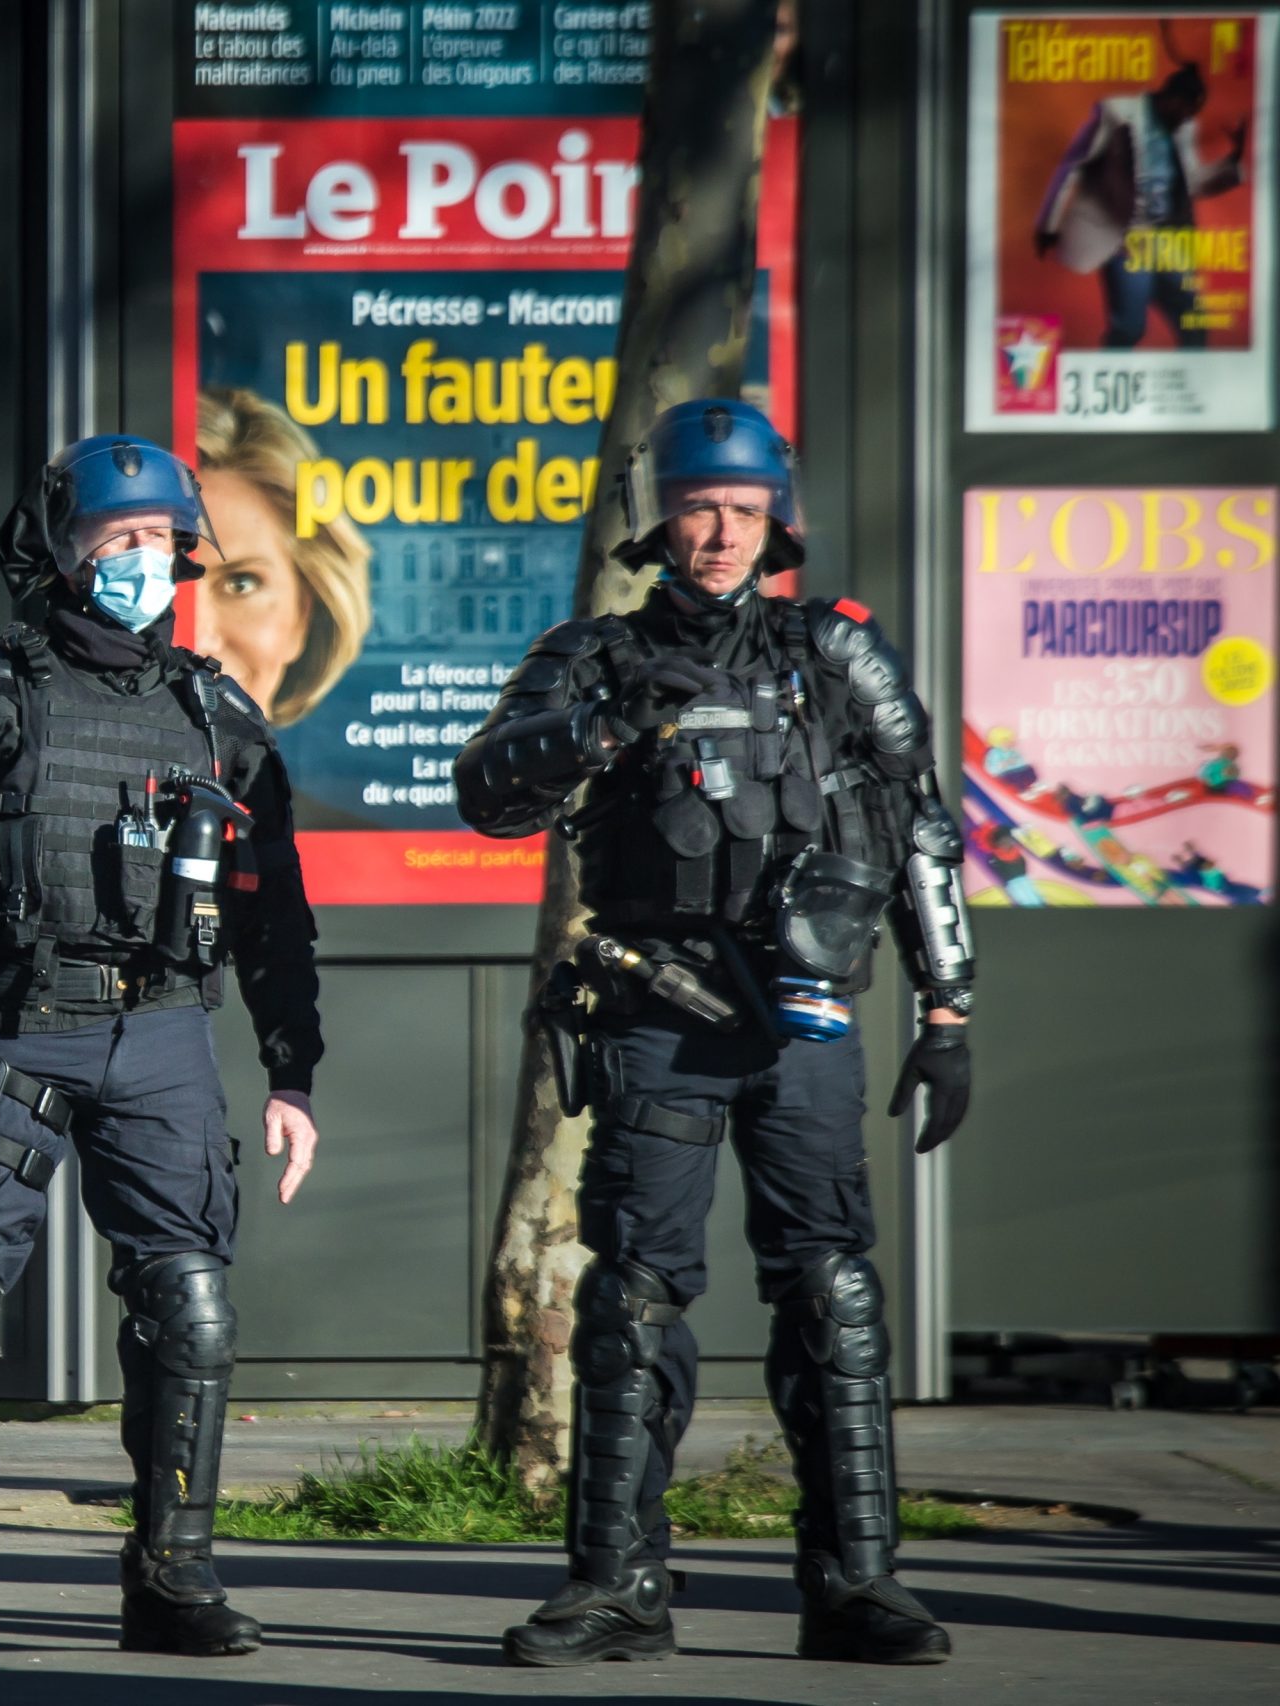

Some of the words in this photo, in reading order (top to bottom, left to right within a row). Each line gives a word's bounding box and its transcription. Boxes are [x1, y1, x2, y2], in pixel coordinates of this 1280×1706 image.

[330, 7, 404, 31] Michelin
[474, 8, 517, 30] 2022
[195, 35, 215, 58] Le
[219, 34, 266, 58] tabou
[271, 35, 302, 58] des
[554, 35, 575, 57] Ce
[619, 33, 651, 57] fau
[1004, 24, 1153, 82] Télérama
[195, 61, 312, 86] maltraitances
[330, 62, 352, 85] du
[357, 62, 401, 88] pneu
[422, 62, 452, 85] des
[554, 62, 583, 85] des
[238, 143, 375, 240] Le
[1124, 229, 1246, 272] STROMAE
[352, 290, 479, 326] Pécresse
[508, 291, 620, 326] Macron
[286, 341, 388, 425] Un
[296, 457, 473, 538] pour
[977, 494, 1276, 574] L'OBS
[1024, 600, 1224, 658] PARCOURSUP
[401, 664, 424, 686] La
[427, 663, 489, 686] féroce
[1054, 680, 1099, 706] LES
[1104, 663, 1188, 706] 350
[371, 692, 418, 714] pour
[420, 689, 438, 711] la
[346, 722, 370, 745] Ce
[373, 722, 405, 749] qui
[408, 722, 438, 745] les
[440, 722, 484, 745] dist
[1020, 708, 1223, 740] FORMATIONS
[412, 757, 437, 778] La
[363, 783, 392, 805] du
[409, 783, 457, 808] quoi
[404, 847, 476, 868] Spécial
